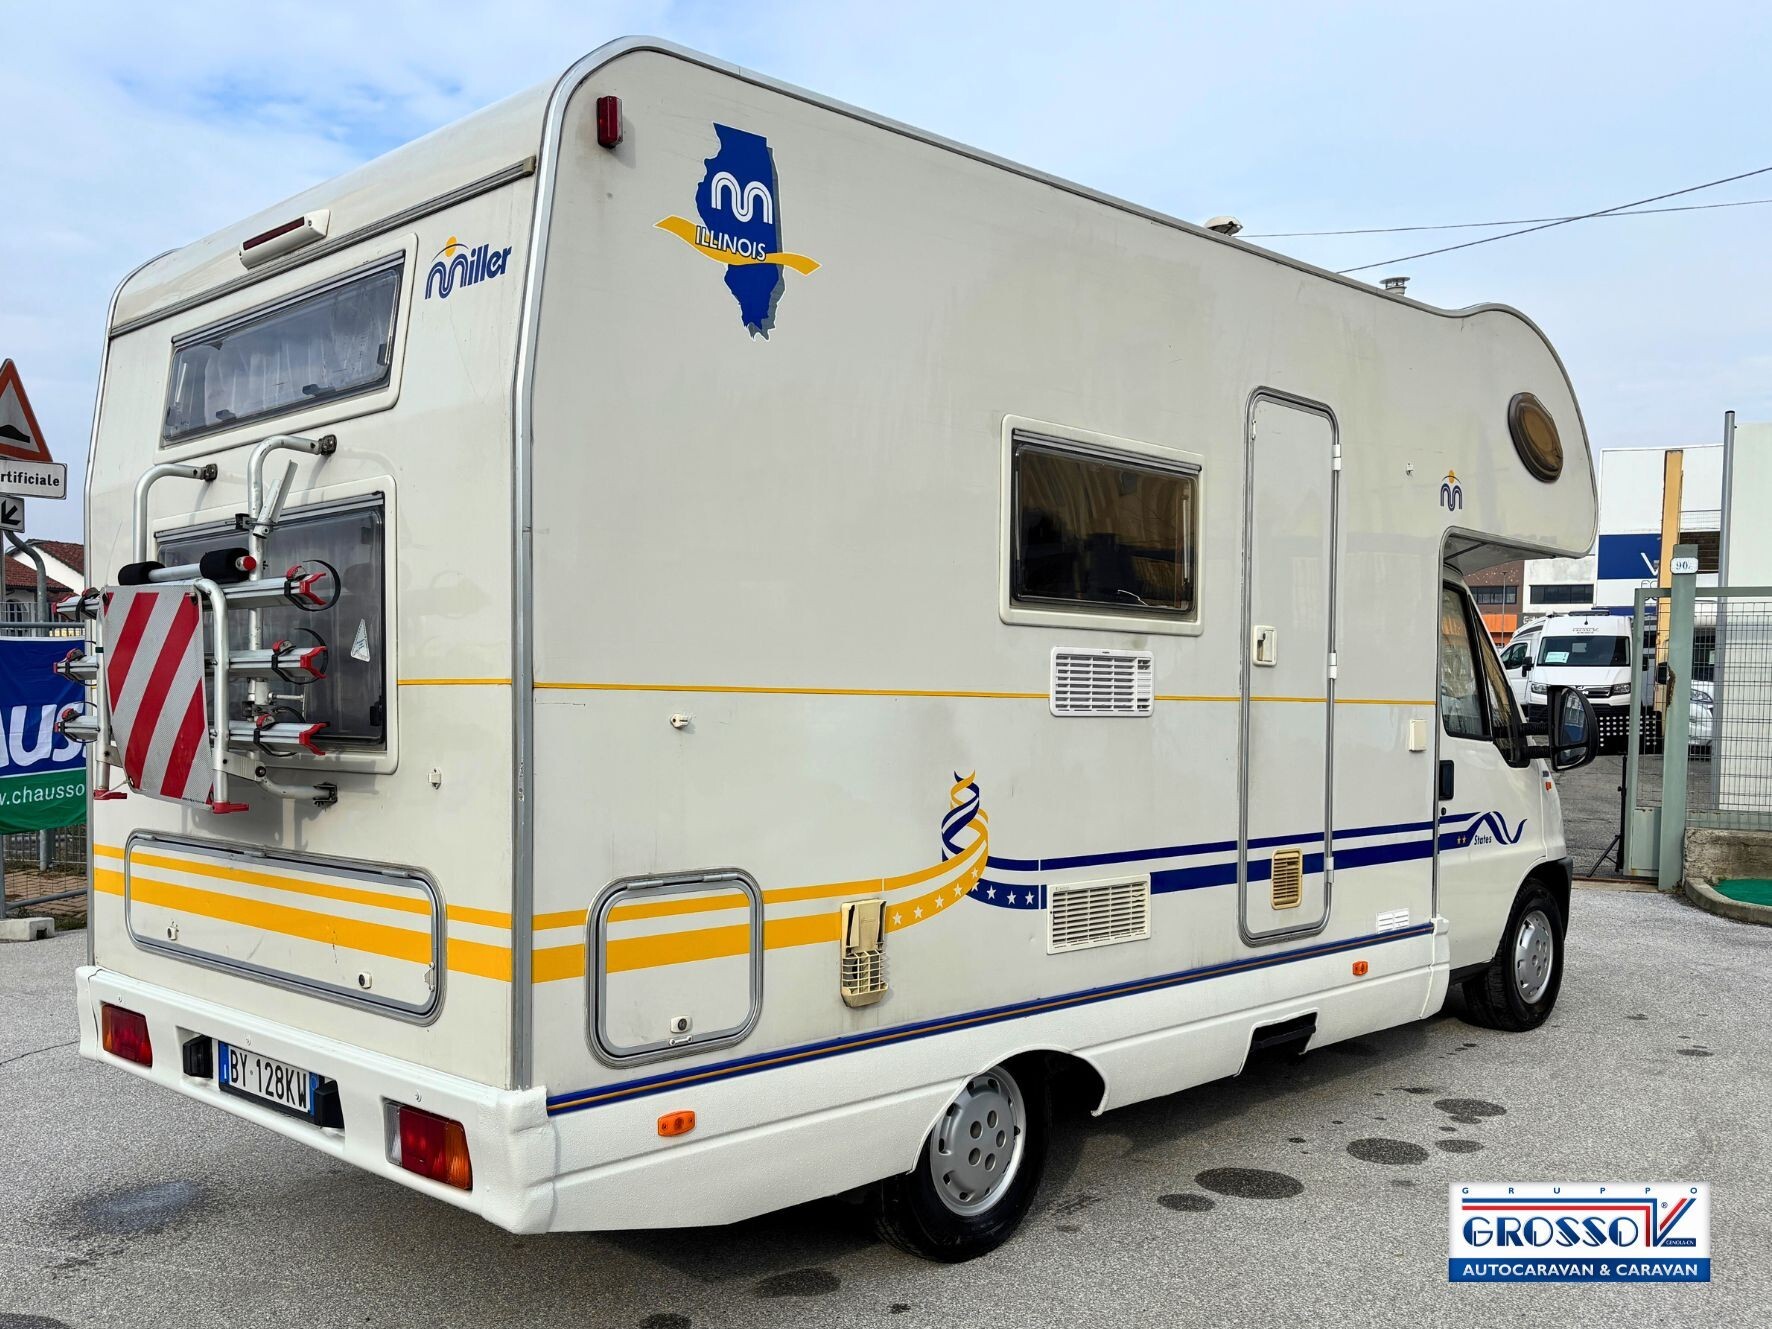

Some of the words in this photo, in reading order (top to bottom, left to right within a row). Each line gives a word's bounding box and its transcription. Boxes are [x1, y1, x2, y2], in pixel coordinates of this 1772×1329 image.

[694, 225, 766, 261] ILLINOIS
[1474, 834, 1492, 845] States
[230, 1049, 247, 1087] BY
[256, 1058, 306, 1109] 128KW
